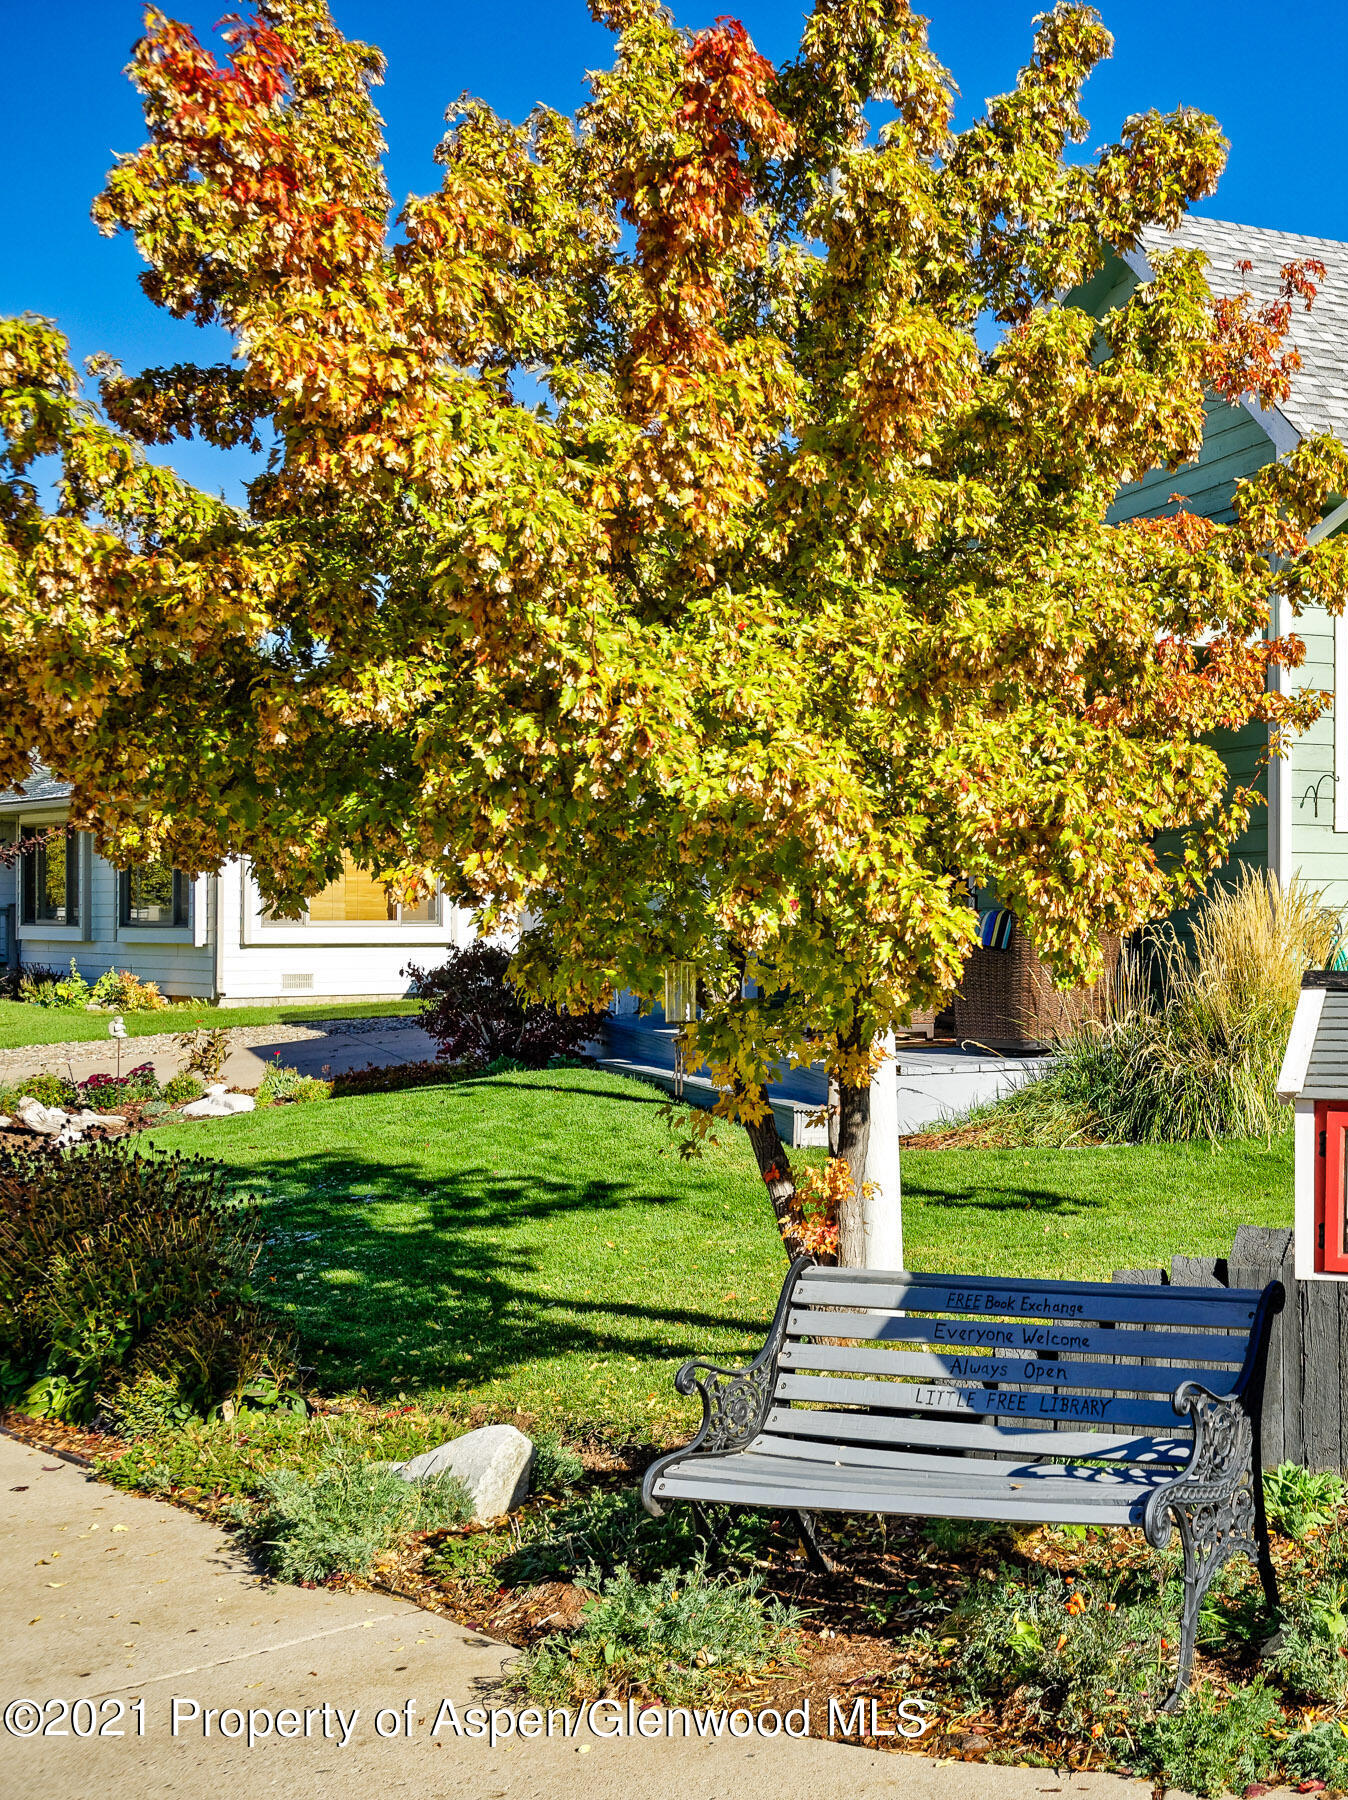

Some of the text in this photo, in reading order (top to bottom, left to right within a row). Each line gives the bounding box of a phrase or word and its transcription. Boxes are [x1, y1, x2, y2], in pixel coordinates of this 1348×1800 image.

[946, 1292, 1084, 1316] FREE Book Exchange
[934, 1323, 1090, 1348] Everyone Welcome
[950, 1359, 1067, 1380] Always Open
[915, 1388, 1112, 1418] LITTLE FREE LIBRARY
